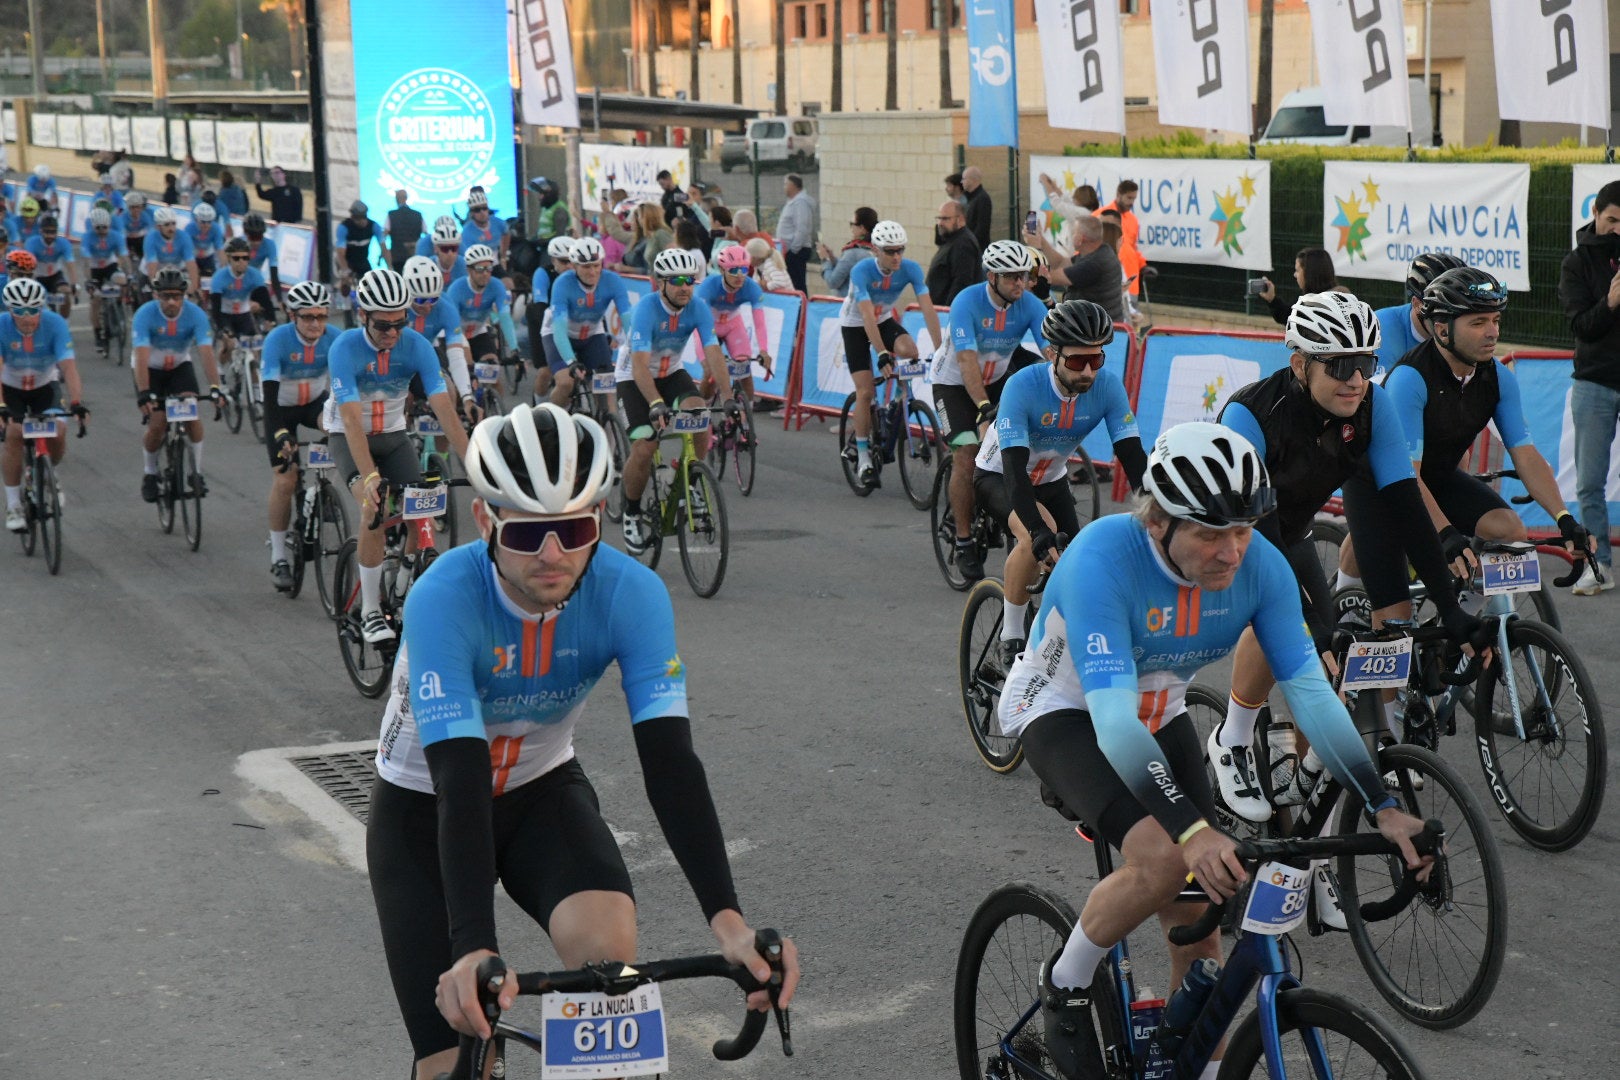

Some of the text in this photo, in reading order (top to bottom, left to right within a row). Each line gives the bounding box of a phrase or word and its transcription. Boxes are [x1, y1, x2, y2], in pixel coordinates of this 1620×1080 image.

[389, 115, 485, 142] CRITERIUM
[1387, 203, 1410, 235] LA
[1147, 225, 1202, 249] DEPORTE
[1460, 247, 1521, 270] DEPORTE
[414, 496, 438, 510] 682
[1497, 562, 1525, 580] 161
[1360, 656, 1397, 674] 403
[591, 1001, 603, 1016] LA
[606, 997, 635, 1016] NUCIA
[573, 1017, 639, 1053] 610
[571, 1055, 596, 1063] ADRIAN
